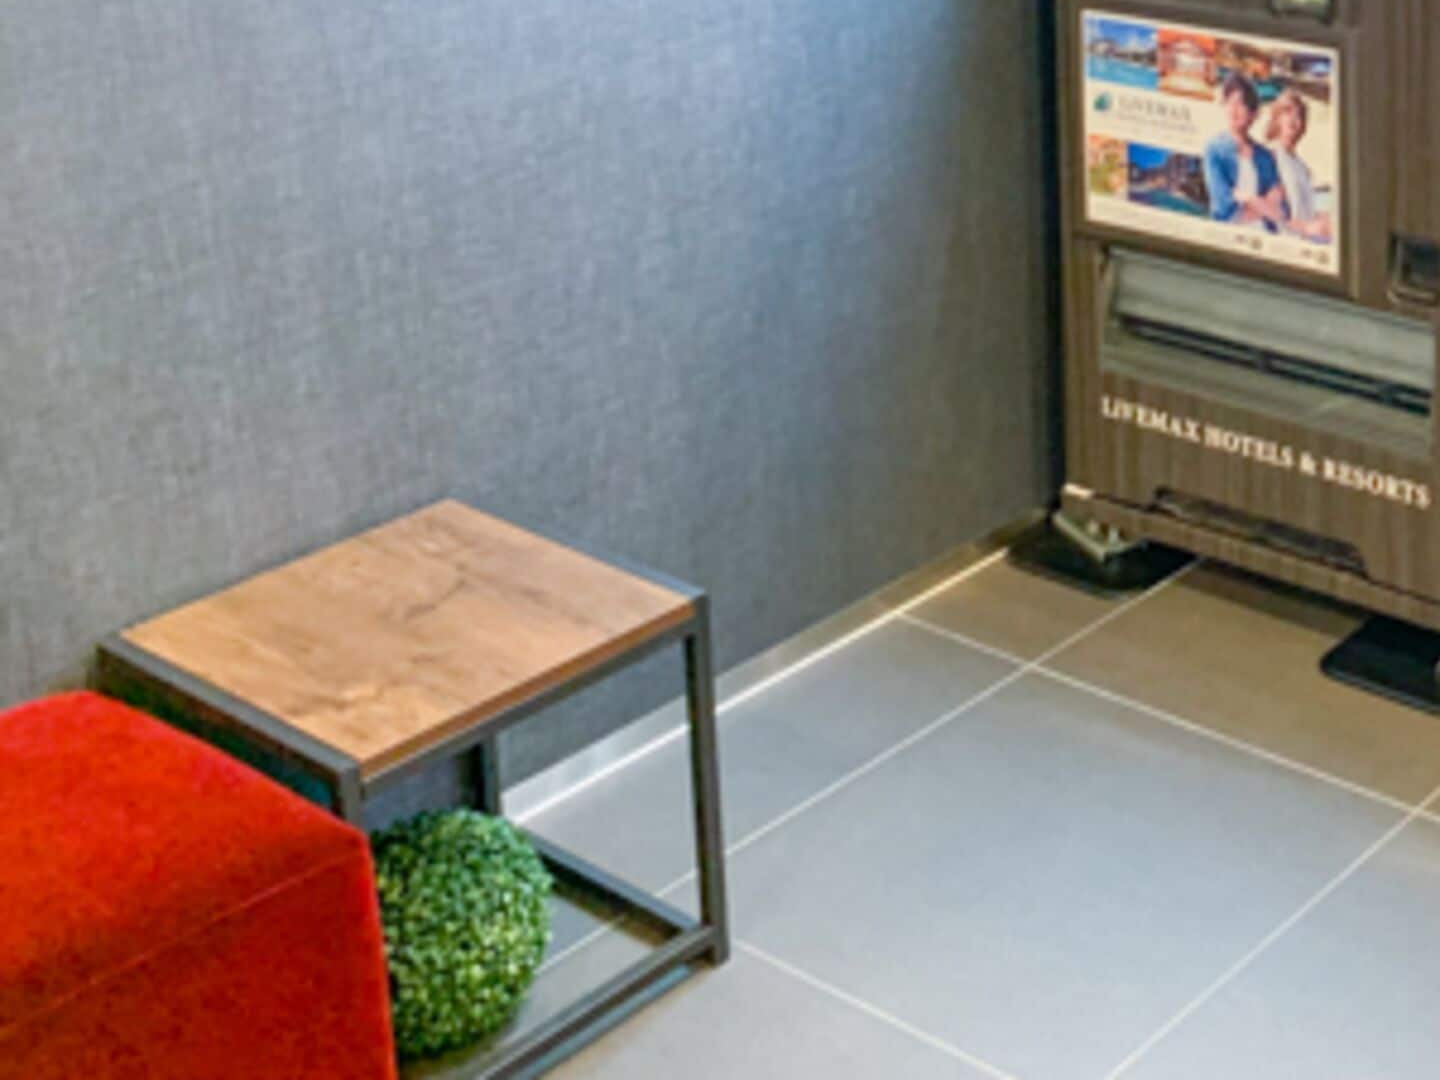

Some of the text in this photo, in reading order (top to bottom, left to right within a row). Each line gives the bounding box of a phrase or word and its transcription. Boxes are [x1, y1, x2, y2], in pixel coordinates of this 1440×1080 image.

[1204, 424, 1294, 468] HOTELS
[1300, 451, 1316, 476] &
[1323, 457, 1432, 510] RESORTS
